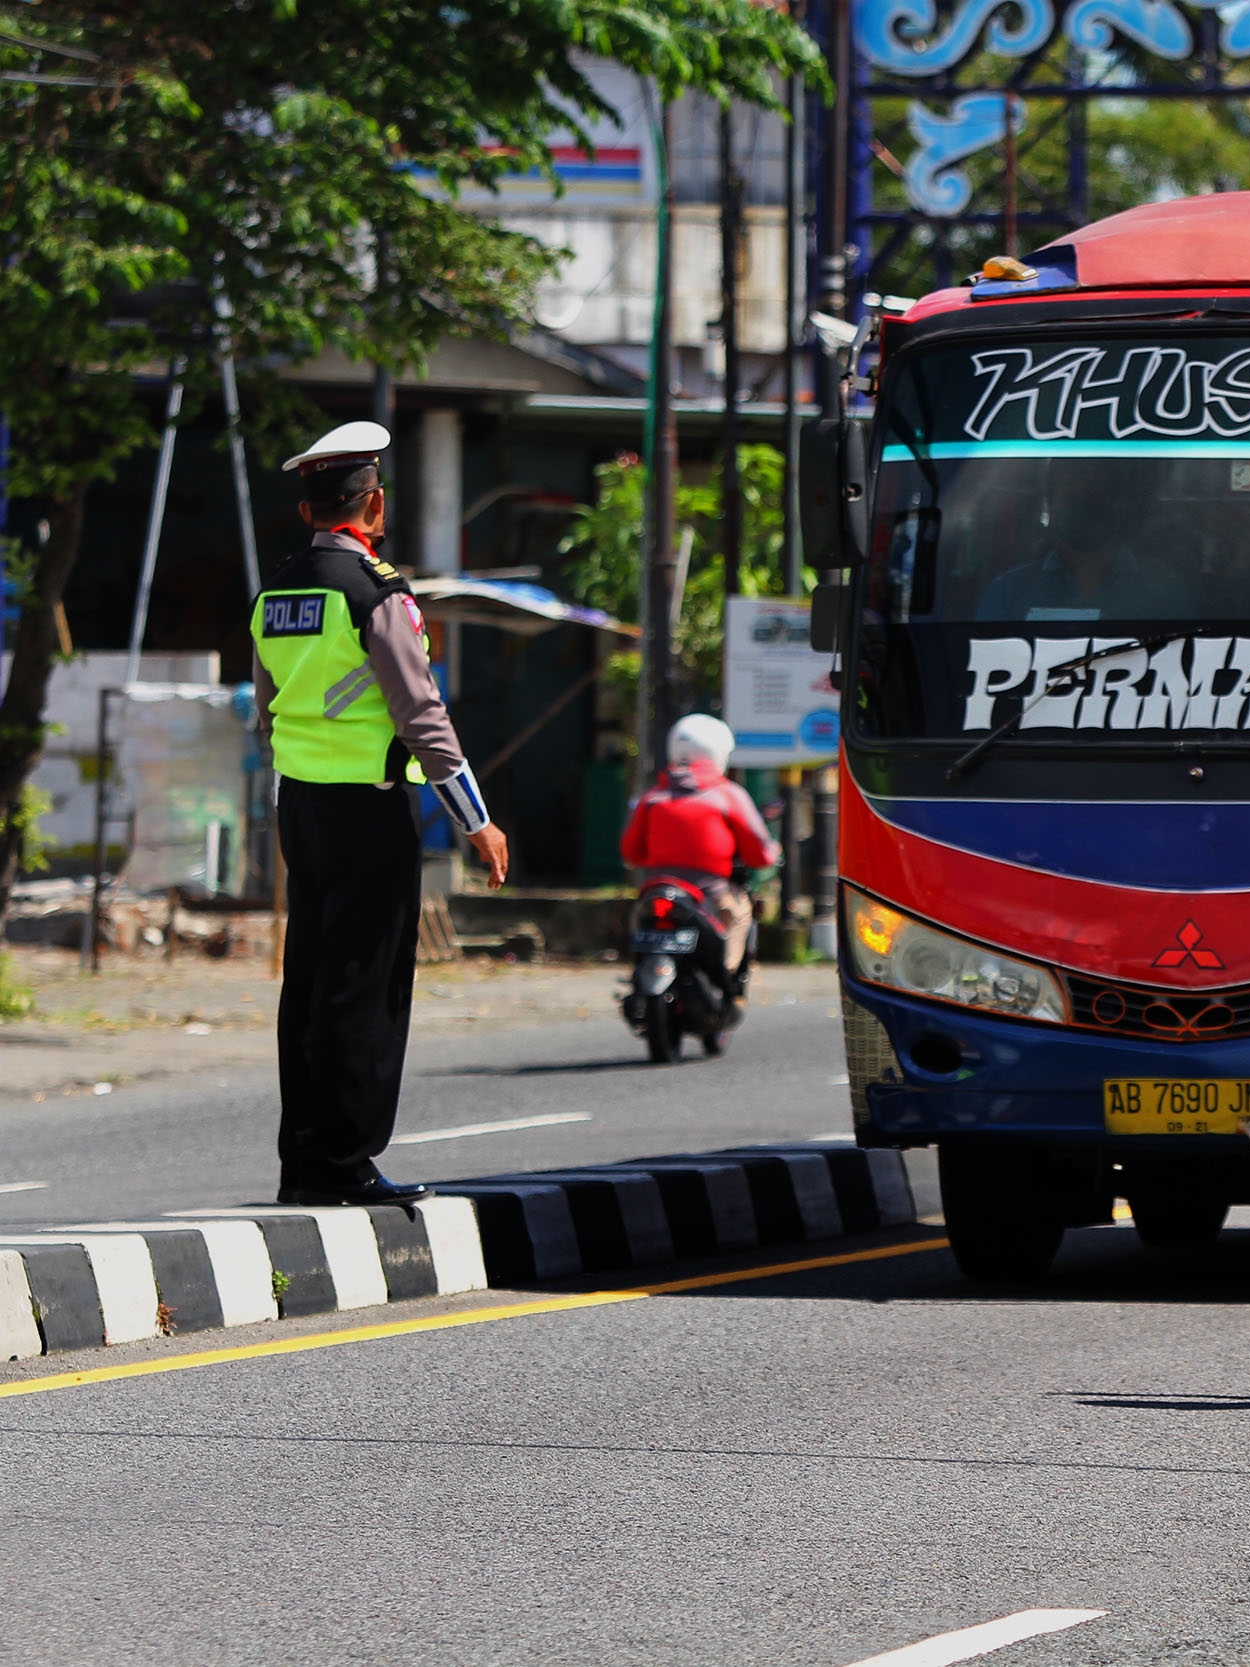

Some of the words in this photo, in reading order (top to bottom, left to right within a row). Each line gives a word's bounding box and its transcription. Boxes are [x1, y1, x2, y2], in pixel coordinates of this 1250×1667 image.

[264, 600, 323, 632] POLISI
[1109, 1083, 1141, 1114] AB
[1153, 1083, 1218, 1114] 7690
